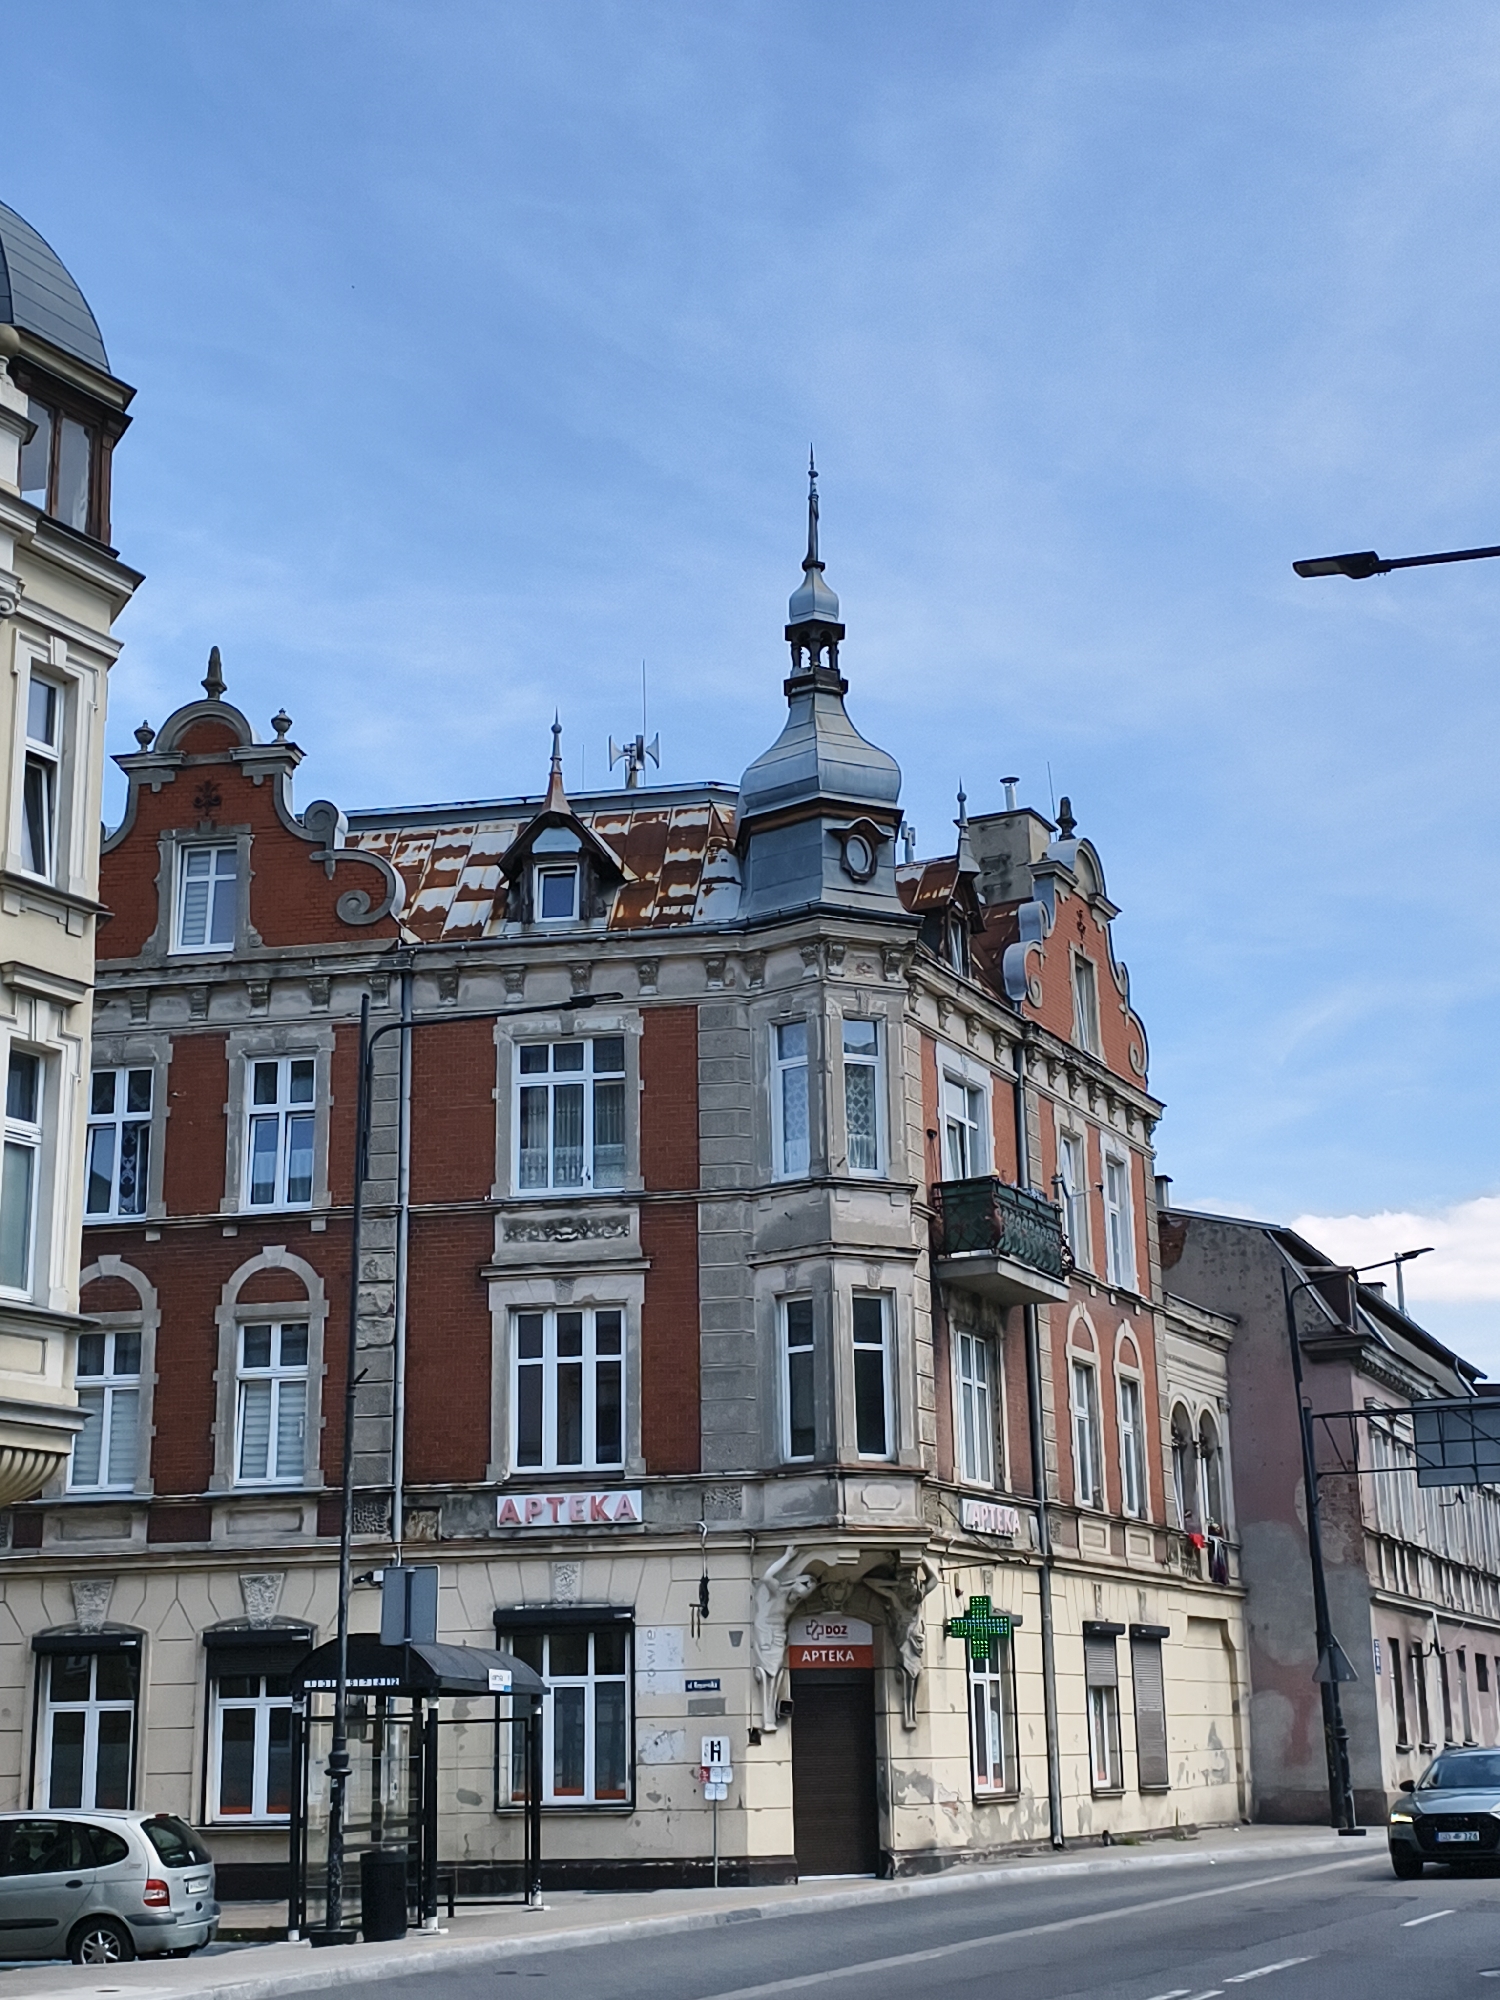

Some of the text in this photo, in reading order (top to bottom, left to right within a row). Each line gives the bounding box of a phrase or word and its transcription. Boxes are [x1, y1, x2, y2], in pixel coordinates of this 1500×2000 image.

[499, 1493, 638, 1524] APTEKA
[972, 1504, 1021, 1537] APTEKA
[825, 1625, 848, 1635] DOZ
[801, 1650, 855, 1662] APTEKA
[710, 1740, 721, 1762] H
